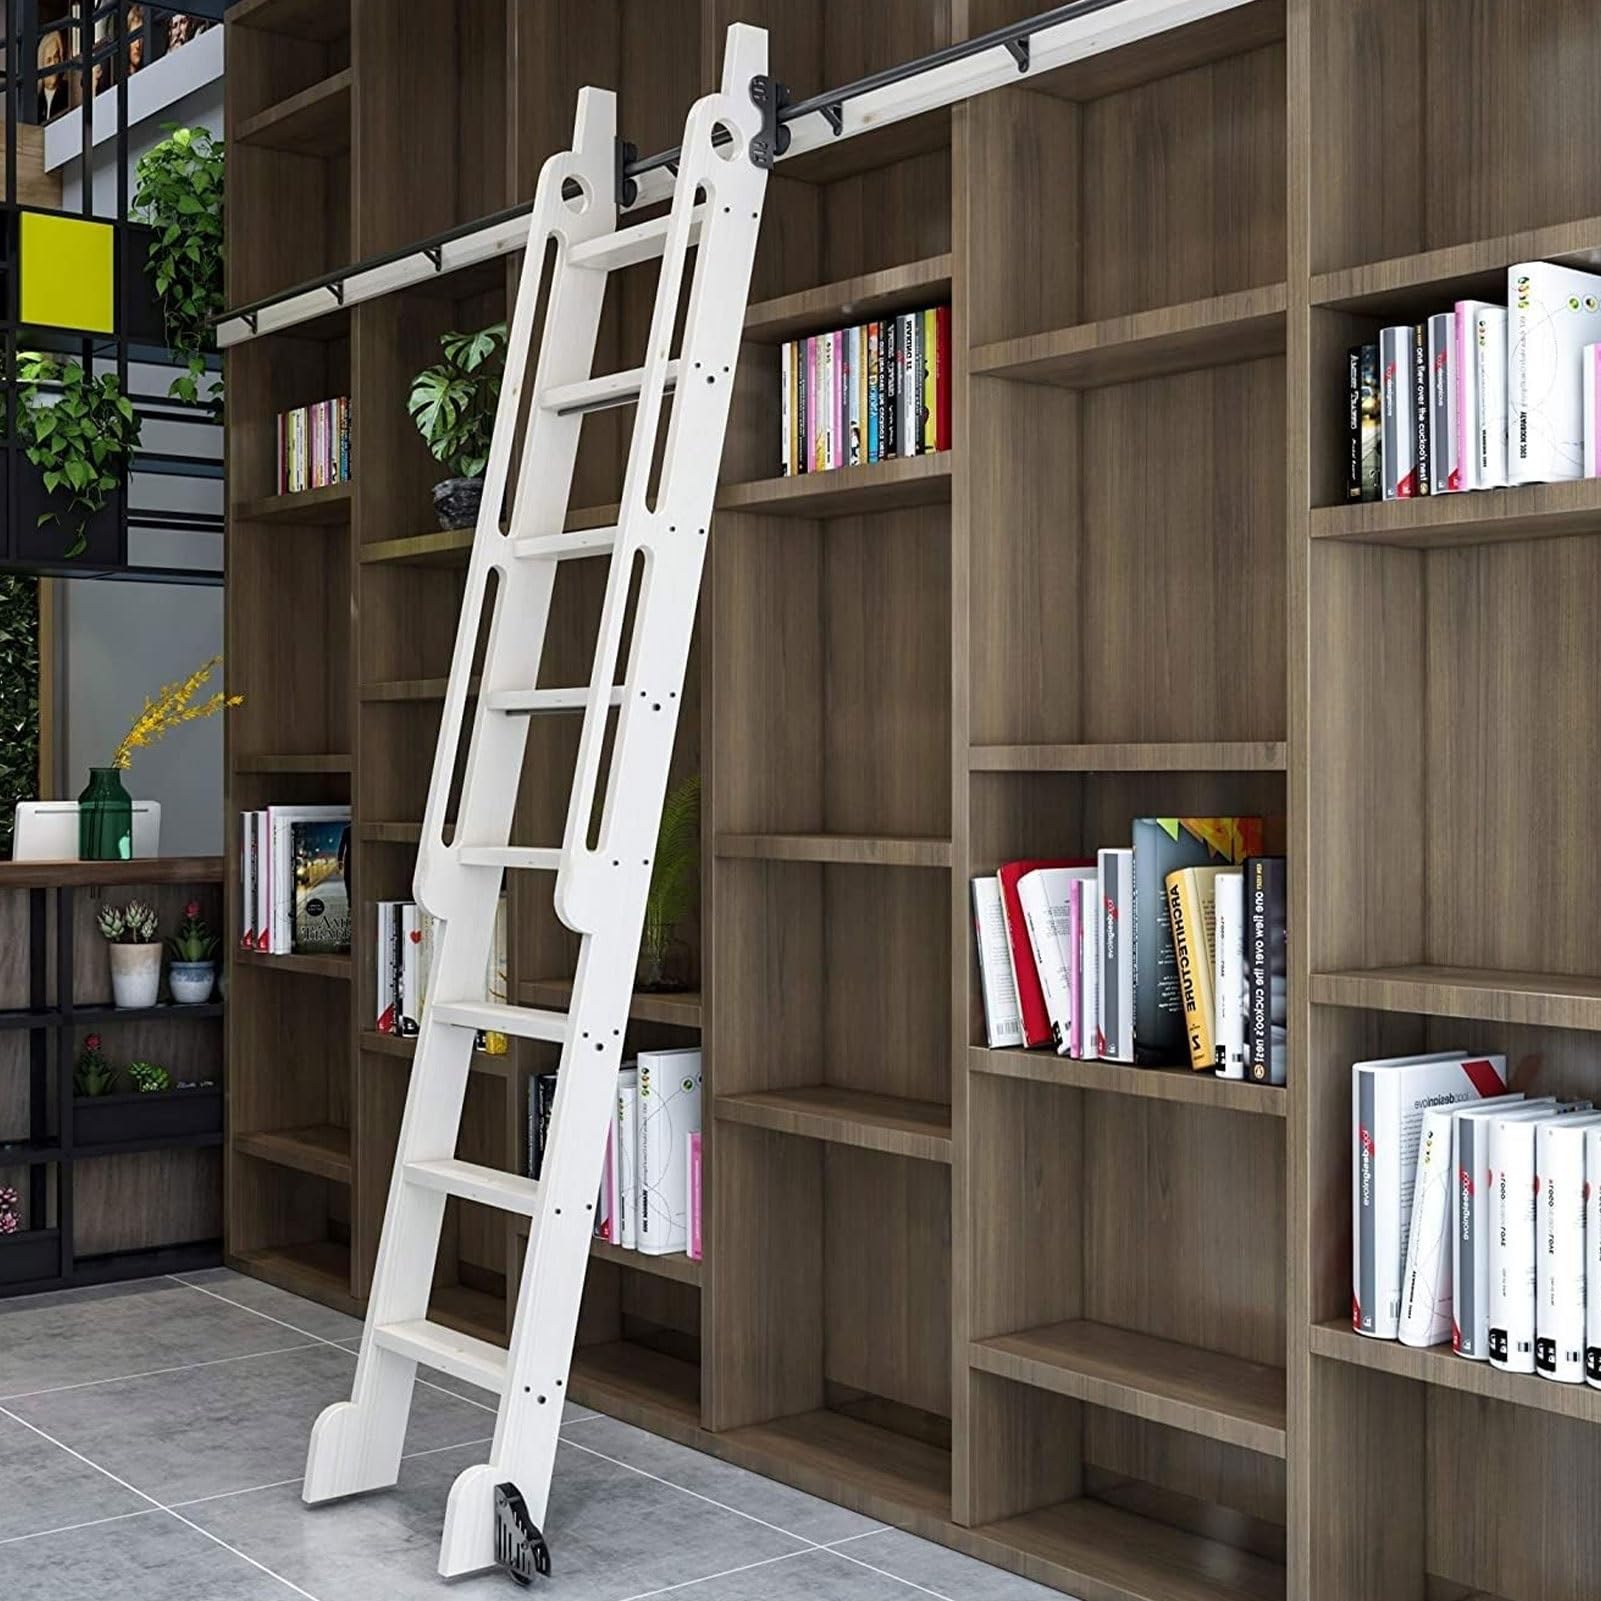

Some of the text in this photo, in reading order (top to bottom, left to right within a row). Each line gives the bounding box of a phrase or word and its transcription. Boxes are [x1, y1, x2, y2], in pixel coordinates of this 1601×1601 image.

[1416, 365, 1425, 384] flew
[1417, 407, 1426, 422] the
[1418, 423, 1427, 461] cuckoo's
[1419, 462, 1427, 481] nest
